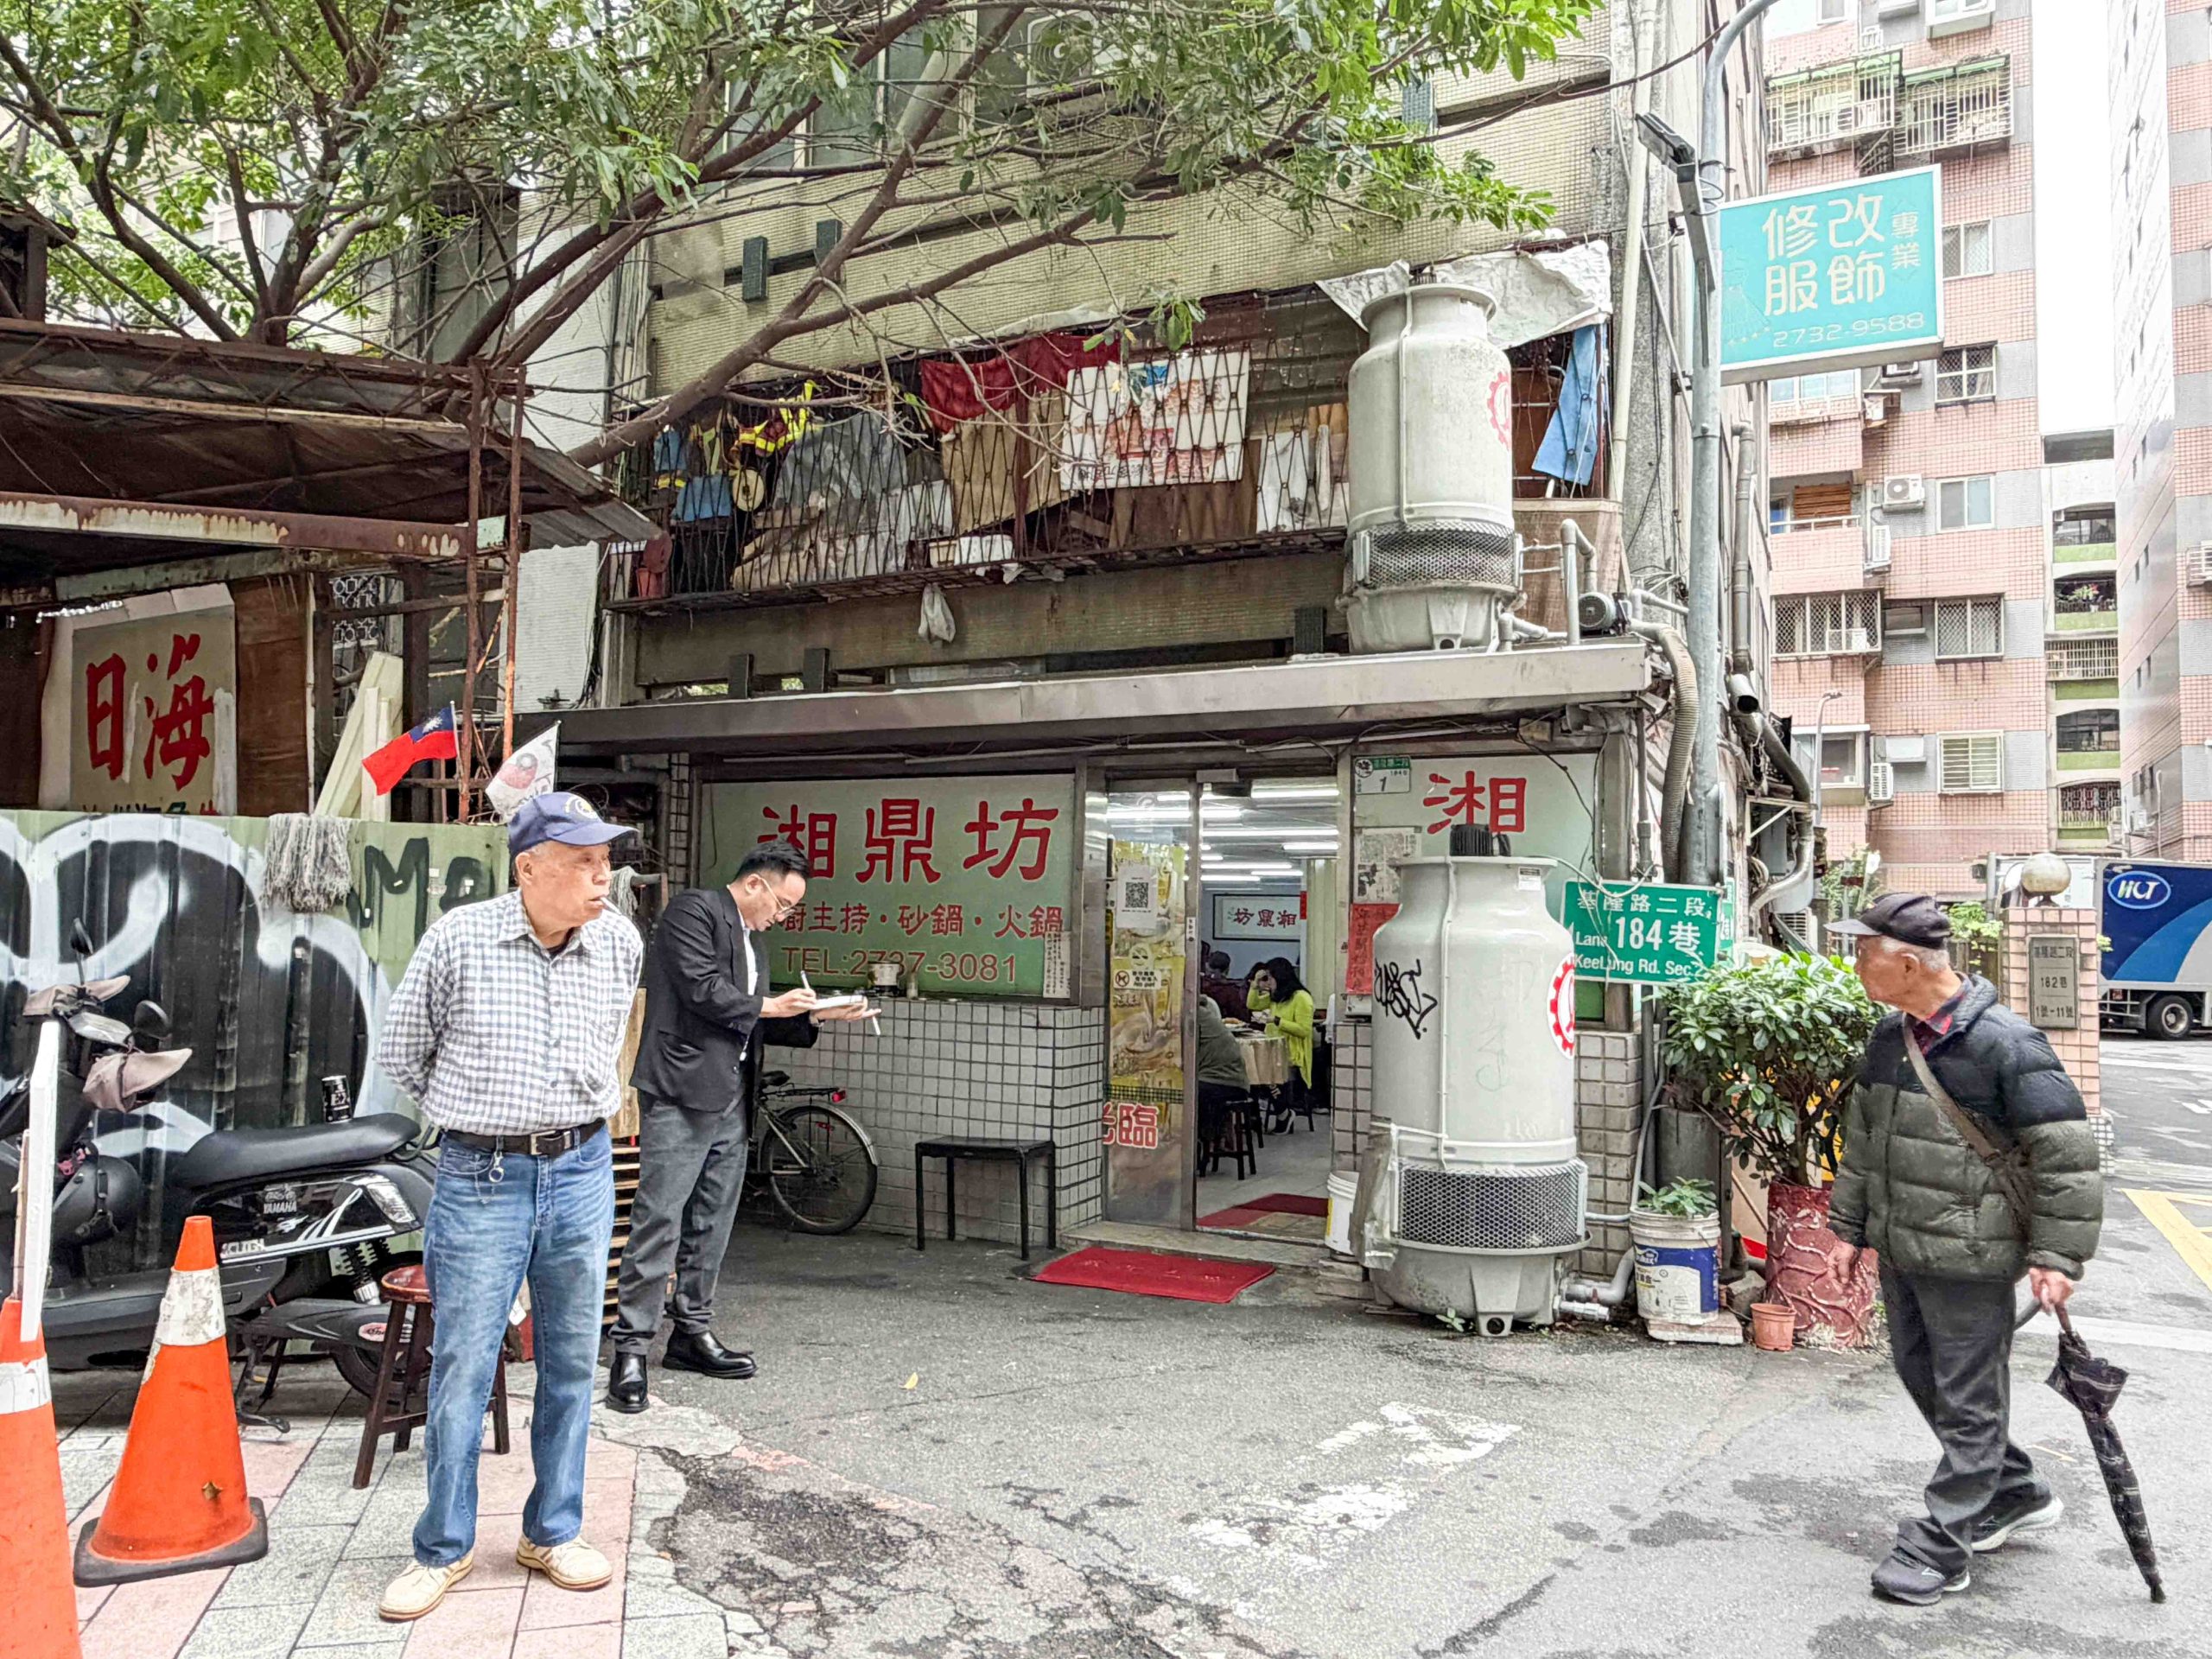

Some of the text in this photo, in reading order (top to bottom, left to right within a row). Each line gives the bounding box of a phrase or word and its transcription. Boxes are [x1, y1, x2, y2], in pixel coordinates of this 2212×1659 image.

[1891, 211, 1922, 270] 專業
[1773, 312, 1925, 347] 2732-9588
[1423, 770, 1528, 835] 湘
[757, 798, 1059, 884] 湘鼎坊
[1577, 890, 1707, 918] 基隆路二段
[1575, 931, 1608, 947] Lane
[1638, 959, 1661, 975] Rd.
[263, 1201, 297, 1215] YAMAHA
